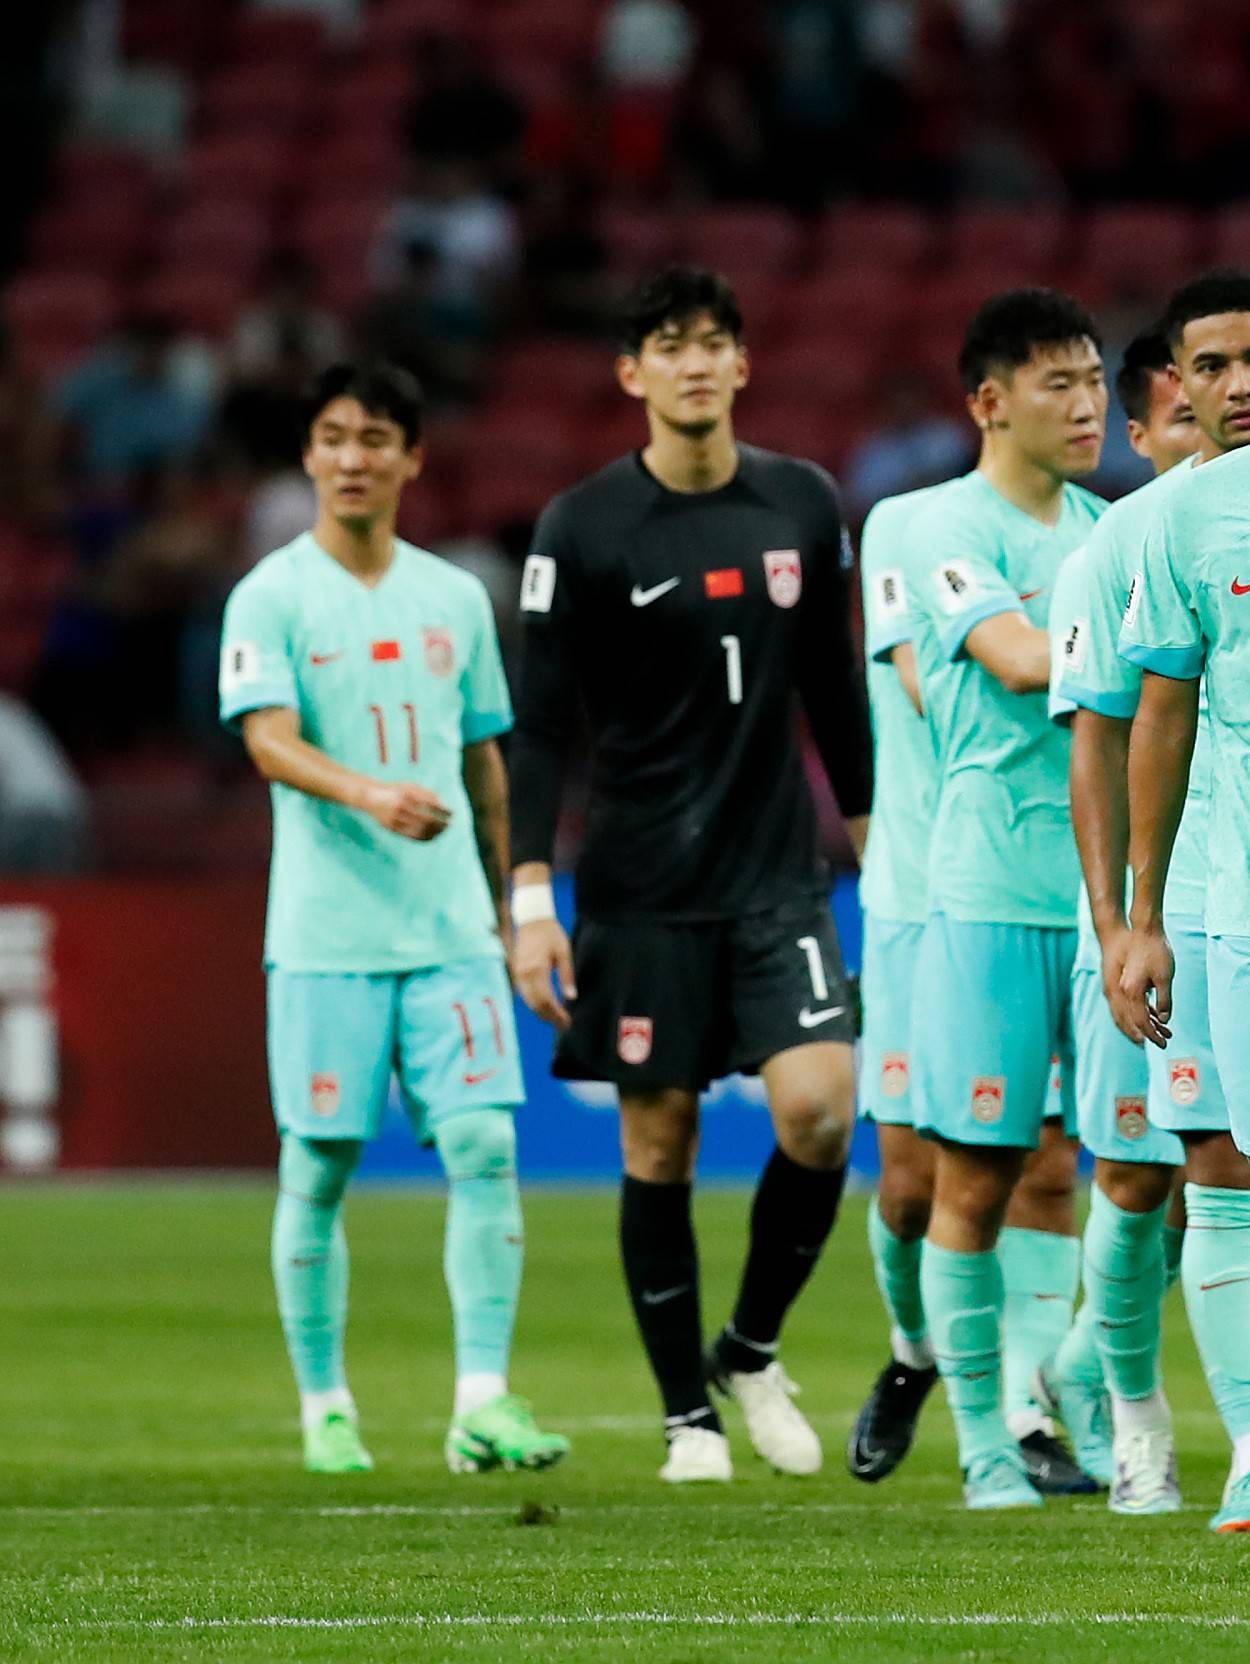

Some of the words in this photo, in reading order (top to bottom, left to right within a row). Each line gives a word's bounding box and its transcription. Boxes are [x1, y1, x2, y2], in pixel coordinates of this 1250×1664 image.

[720, 634, 743, 704] 1
[369, 702, 418, 764] 11
[796, 935, 829, 1001] 1
[451, 996, 506, 1058] 11
